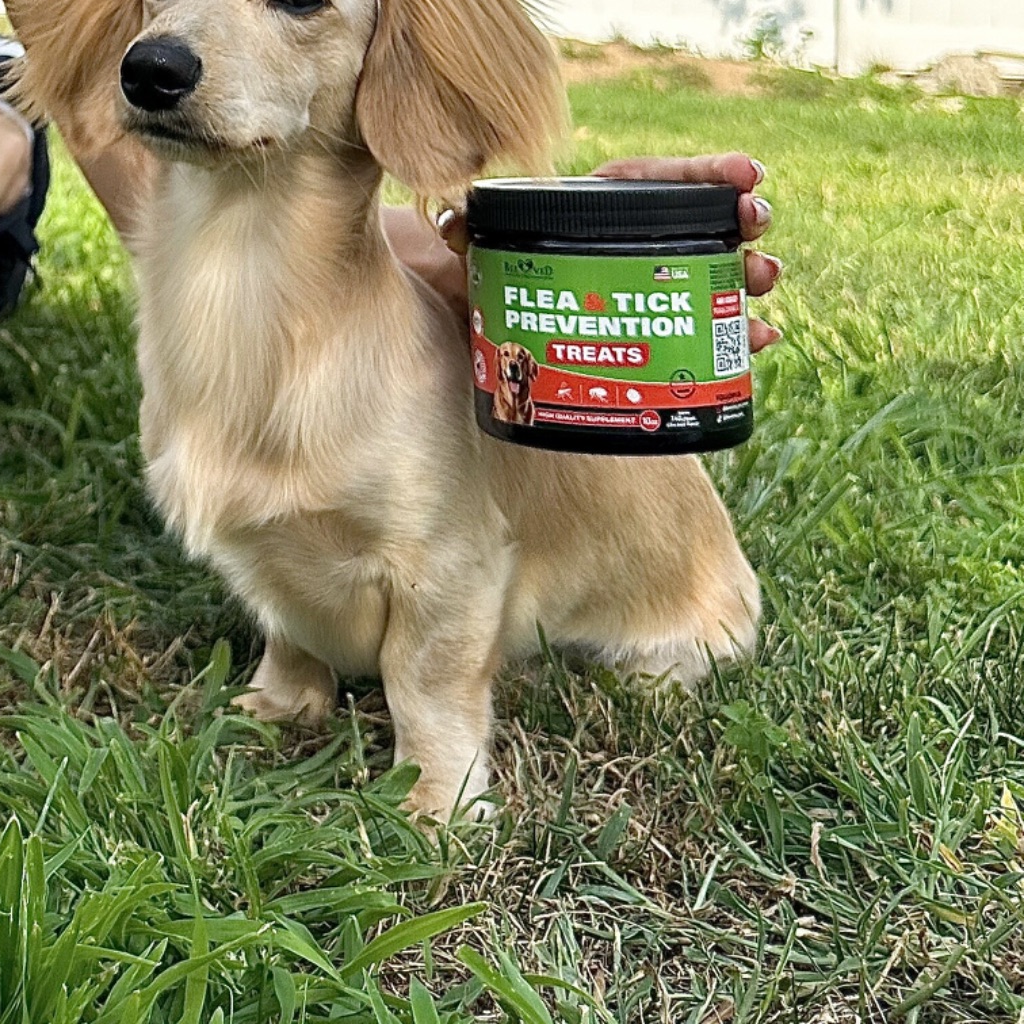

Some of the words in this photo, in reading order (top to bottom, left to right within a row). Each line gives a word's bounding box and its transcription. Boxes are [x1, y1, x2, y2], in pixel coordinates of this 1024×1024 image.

[504, 286, 580, 311] FLEA
[583, 292, 606, 312] &
[612, 292, 693, 313] TICK
[505, 310, 695, 337] PREVENTION
[552, 344, 643, 363] TREATS
[586, 415, 636, 425] SUPPLEMENT
